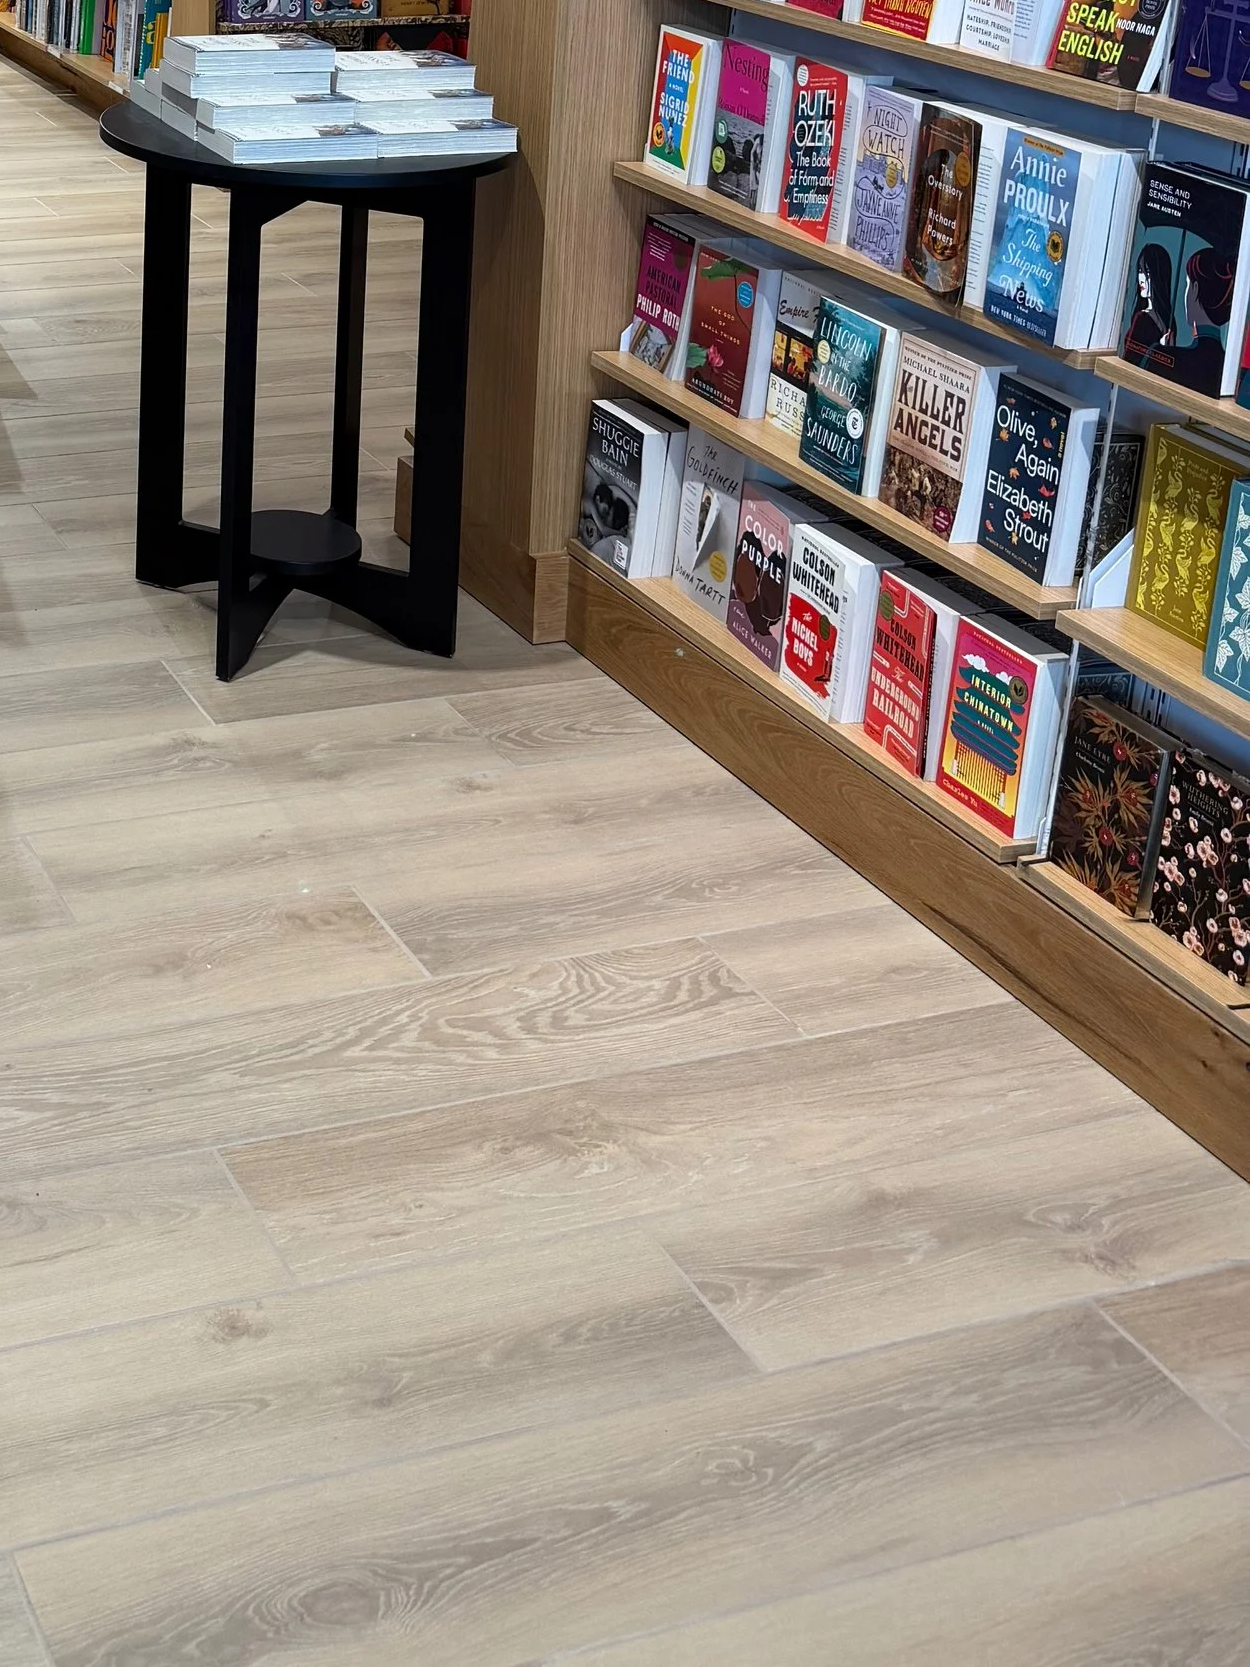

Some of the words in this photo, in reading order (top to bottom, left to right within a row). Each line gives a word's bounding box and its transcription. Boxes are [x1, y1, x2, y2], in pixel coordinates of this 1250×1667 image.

[1066, 2, 1119, 33] SPEAK
[672, 50, 689, 66] THE
[1058, 30, 1124, 65] ENGLISH
[663, 60, 694, 84] FRIEND
[798, 89, 835, 116] RUTH
[794, 120, 835, 146] OZEKI
[869, 131, 905, 158] WATCH
[1010, 146, 1067, 187] Annie
[928, 174, 963, 201] Overstory
[1003, 179, 1069, 227] PROULX
[1148, 189, 1192, 210] SENSIBILITY
[1150, 179, 1172, 194] SENSE
[928, 207, 956, 230] Richard
[1002, 243, 1053, 286] Shipping
[637, 294, 661, 322] PHILIP
[999, 274, 1044, 313] News
[820, 316, 872, 361] LINCOLN
[818, 367, 856, 403] BARDO
[903, 356, 938, 379] MICHAEL
[939, 370, 970, 394] SHAARA
[898, 369, 967, 435] KILLER
[592, 417, 640, 458] SHUGGIE
[601, 439, 628, 467] BAIN
[806, 419, 858, 465] SAUNDERS
[893, 408, 963, 462] ANGELS
[1015, 444, 1059, 485] Again
[987, 470, 1052, 527] Elizabeth
[745, 514, 784, 560] COLOR
[1003, 508, 1049, 554] Strout
[742, 539, 783, 584] PURPLE
[802, 547, 836, 586] COLSON
[696, 579, 726, 605] TARTT
[792, 560, 839, 614] WHITEHEAD
[791, 617, 818, 651] NICKEL
[793, 638, 813, 667] BOYS
[877, 626, 925, 682] WHITEHEAD
[971, 673, 1013, 709] INTERIOR
[872, 688, 915, 739] RAILROAD
[964, 691, 1014, 733] CHINATOWN
